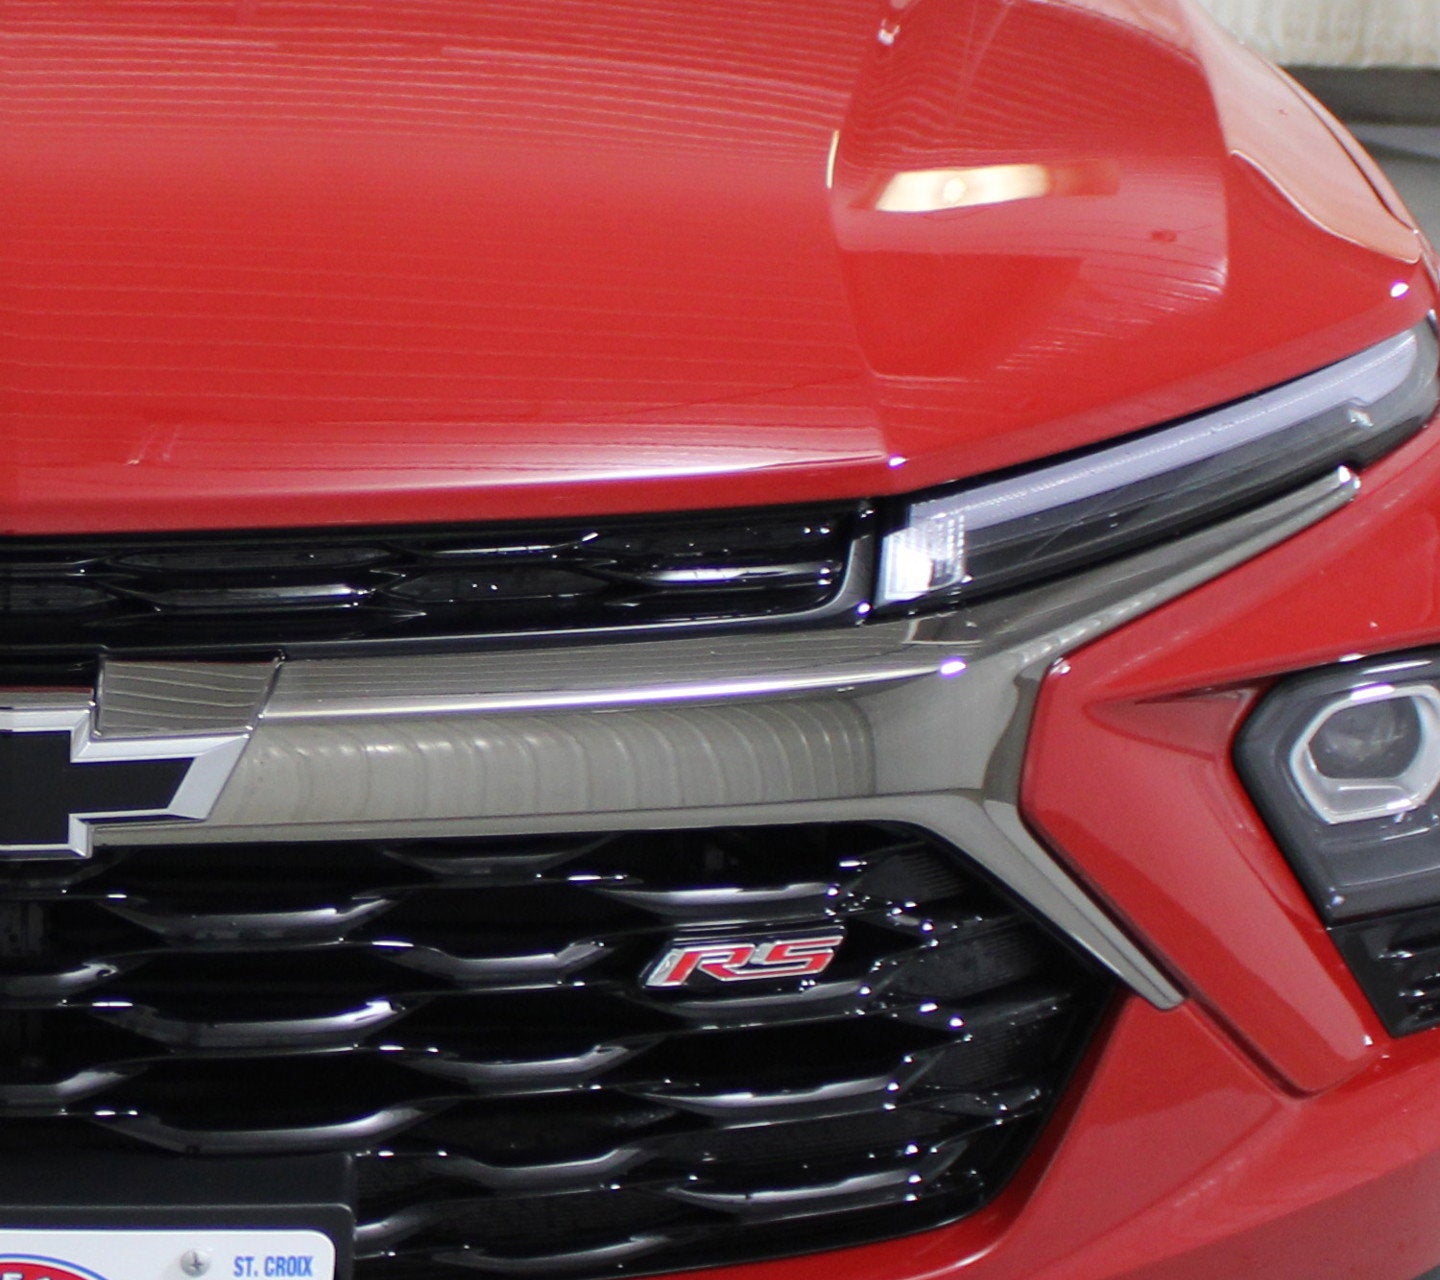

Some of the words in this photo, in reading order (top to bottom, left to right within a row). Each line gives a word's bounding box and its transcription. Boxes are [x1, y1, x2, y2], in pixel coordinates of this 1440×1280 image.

[645, 935, 844, 987] RS
[233, 1256, 260, 1278] ST.
[264, 1256, 314, 1278] CROIX
